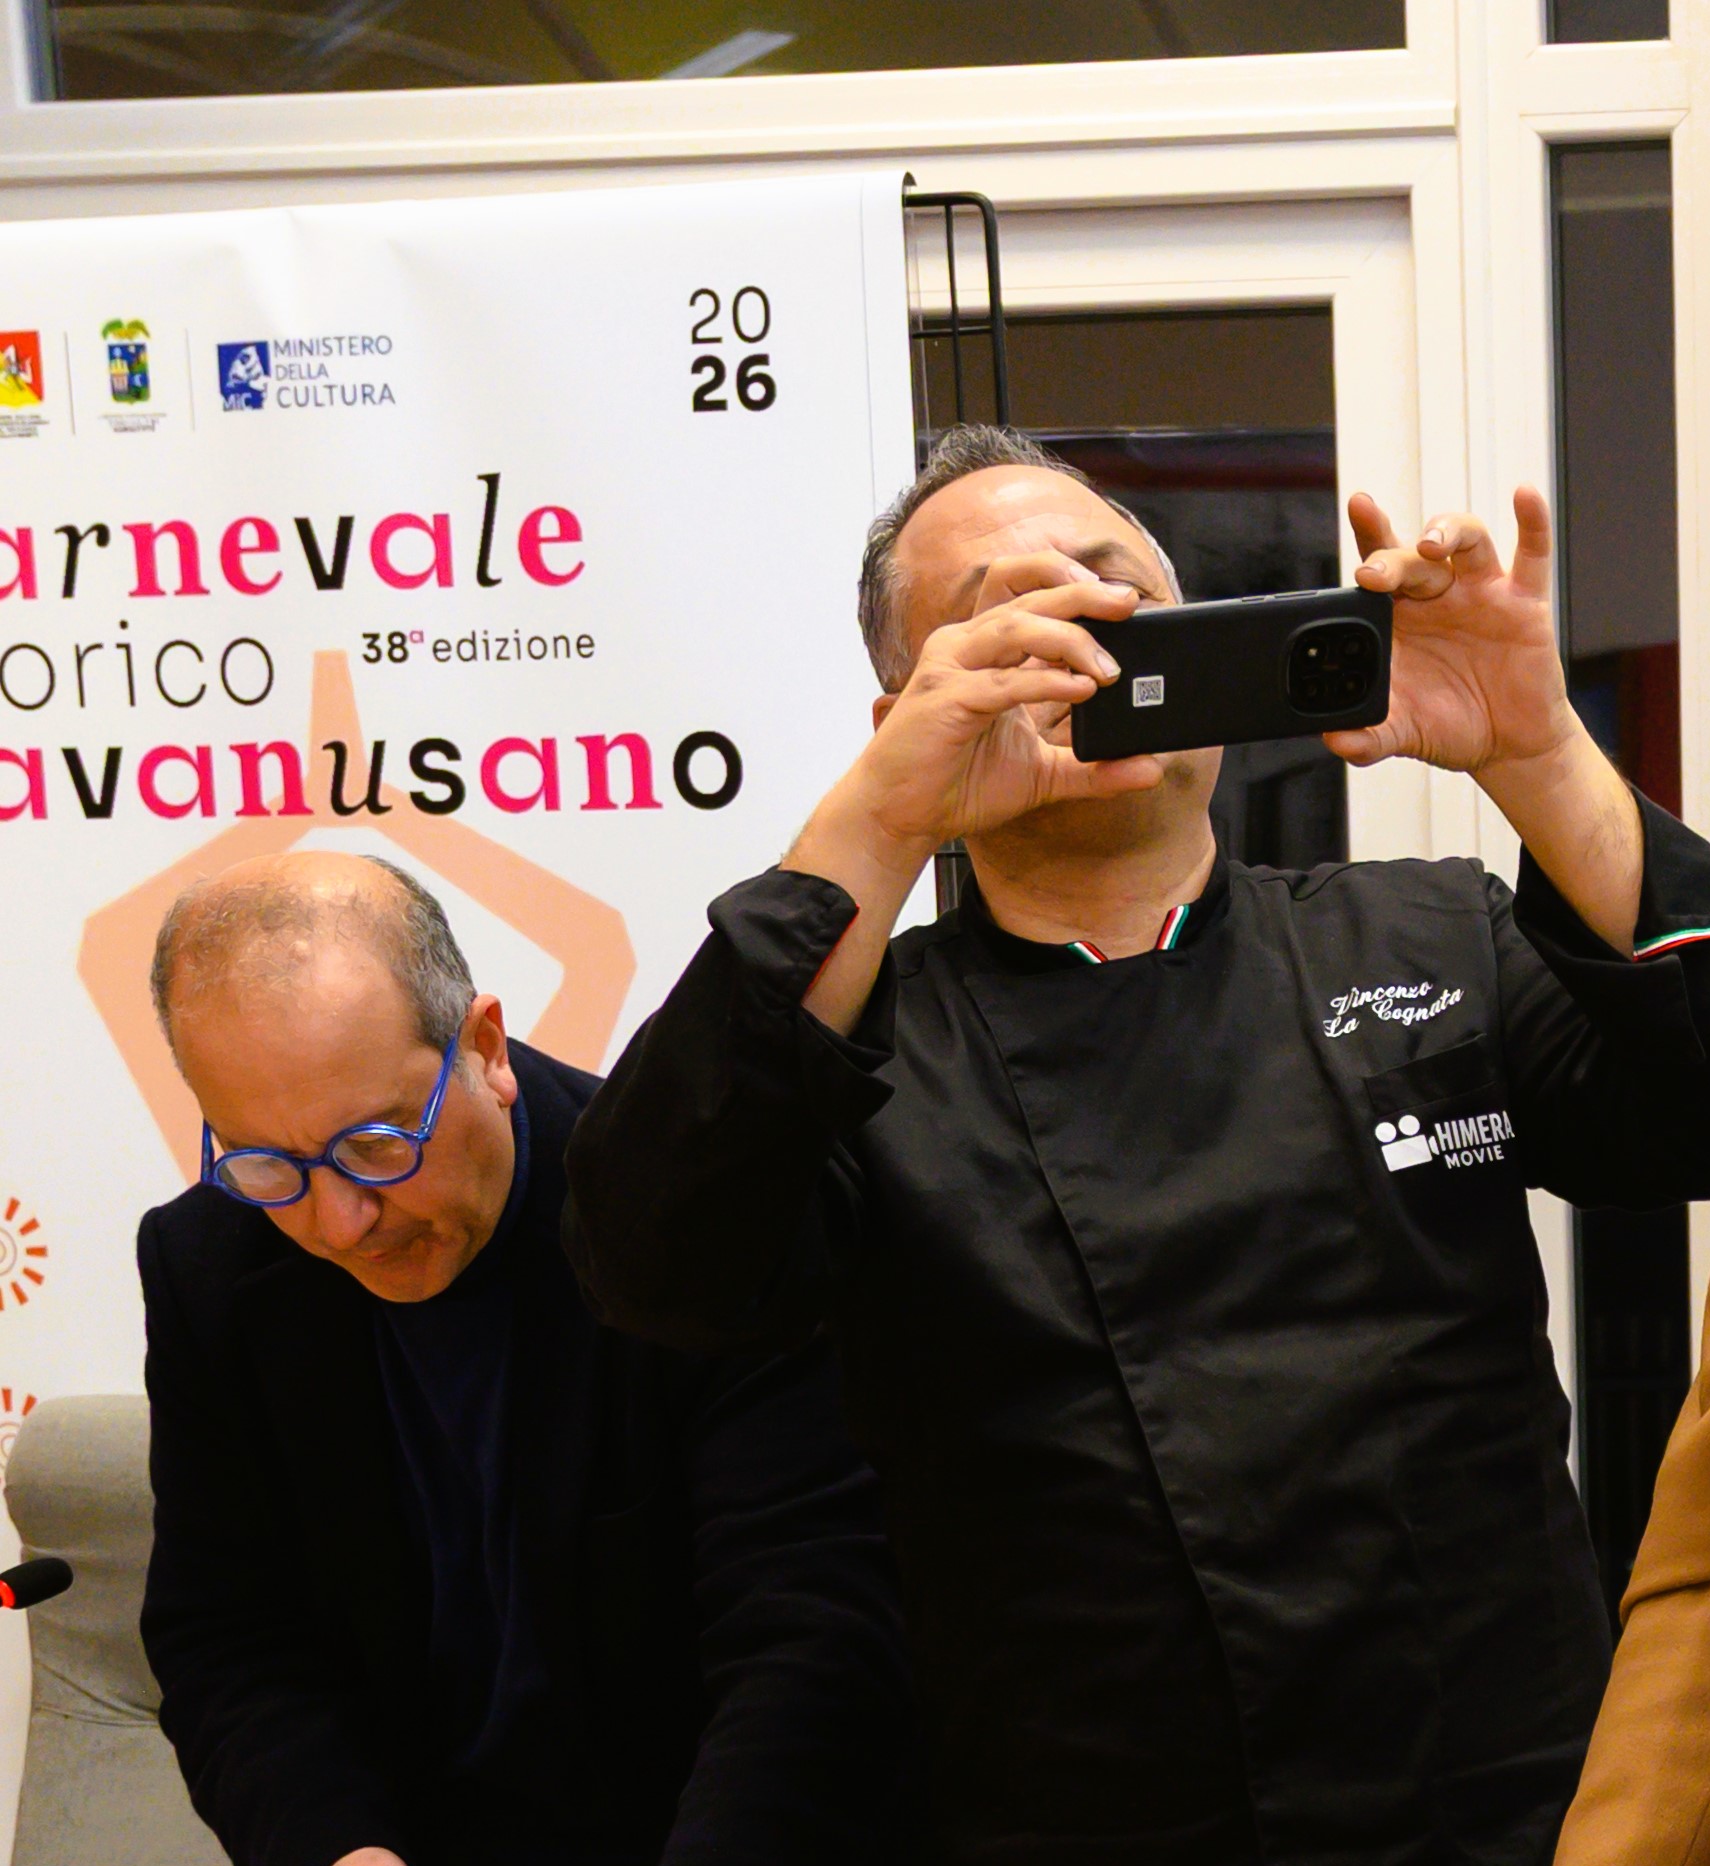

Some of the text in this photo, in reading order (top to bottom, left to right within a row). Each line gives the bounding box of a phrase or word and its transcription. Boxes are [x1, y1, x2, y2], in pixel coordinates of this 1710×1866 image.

[688, 284, 773, 345] 20
[273, 335, 394, 358] MINISTERO
[275, 363, 330, 381] DELLA
[690, 353, 778, 413] 26
[276, 383, 397, 409] CULTURA
[430, 627, 598, 664] edizione
[1322, 987, 1465, 1038] La Cognata
[1329, 980, 1434, 1017] Vincenzo
[1434, 1109, 1516, 1152] HIMERA
[1444, 1144, 1505, 1170] MOVIE
